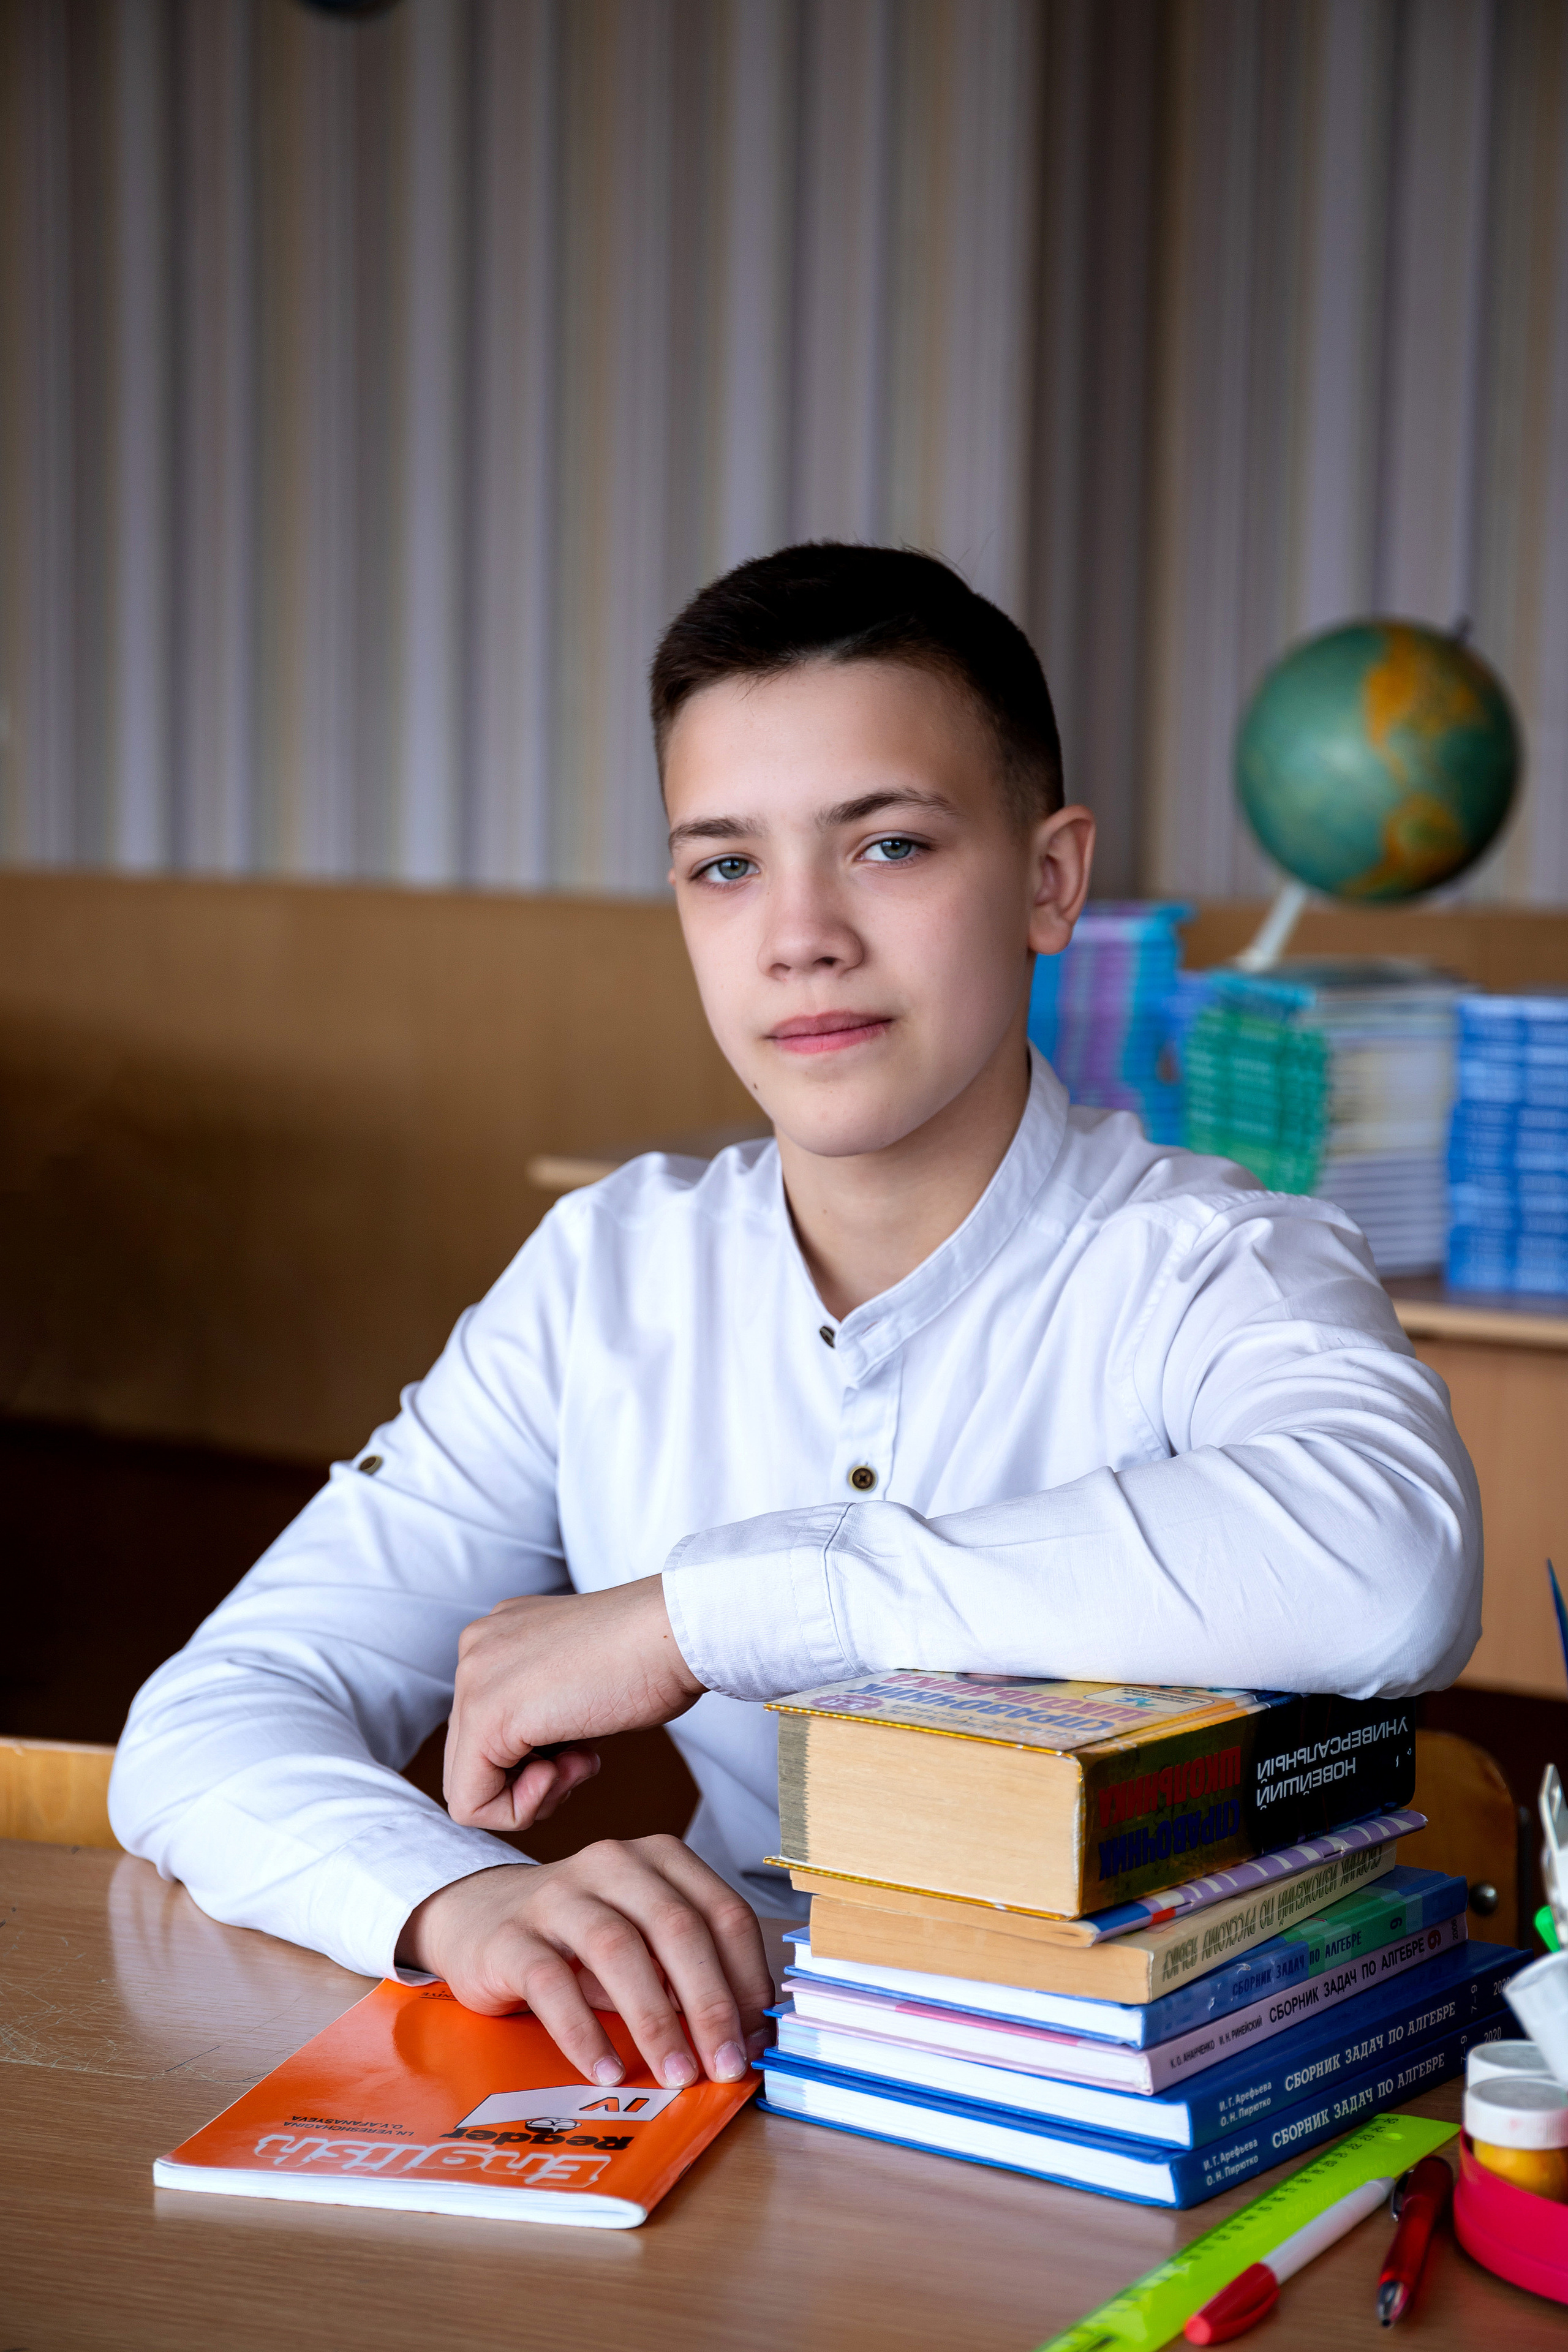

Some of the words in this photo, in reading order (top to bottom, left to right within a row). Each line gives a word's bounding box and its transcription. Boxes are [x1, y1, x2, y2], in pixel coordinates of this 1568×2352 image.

[845, 1683, 1115, 1731] СПРАВОЧНИК
[881, 1674, 1153, 1722] ШКОЛЬНИКА
[1257, 1717, 1408, 1784] УНИВЕРСАЛЬНЫЙ
[1099, 1746, 1242, 1828] ШКОЛЬНИКА
[1257, 1757, 1356, 1810] НОВЕЙШИЙ
[1099, 1799, 1240, 1881] СПРАВОЧНИК
[1340, 1844, 1381, 1887] СБОРНИК
[1259, 1897, 1275, 1930] ПО
[1278, 1863, 1338, 1928] ИЗЛОЖЕНИЙ
[1201, 1905, 1257, 1962] РУССКОМУ
[1390, 1917, 1403, 1930] 9
[1427, 1929, 1442, 1950] 9
[1162, 1936, 1199, 1983] ЯЗЫКУ
[1232, 1969, 1272, 1997] СБОРНИК
[1276, 1953, 1305, 1979] ЗАДАЧ
[1309, 1948, 1321, 1965] ПО
[1325, 1931, 1362, 1958] АЛГЕБРЕ
[1269, 1987, 1319, 2023] СБОРНИК
[1324, 1969, 1358, 1998] ЗАДАЧ
[1362, 1961, 1376, 1980] ПО
[1381, 1937, 1426, 1971] АЛГЕБРЕ
[1183, 2040, 1215, 2062] АНАНЧЕНКО
[1231, 2015, 1263, 2040] РИНЕЙСКИЙ
[1285, 2053, 1341, 2091] СБОРНИК
[1345, 2034, 1384, 2064] ЗАДАЧ
[1389, 2026, 1403, 2045] ПО
[1408, 2002, 1455, 2037] АЛГЕБРЕ
[579, 2097, 650, 2113] IV
[1219, 2100, 1227, 2113] И.
[1228, 2097, 1235, 2108] Г.
[1235, 2082, 1272, 2105] Арефьева
[1221, 2116, 1229, 2127] О.
[1229, 2113, 1238, 2124] Н.
[1238, 2098, 1272, 2119] Пирютко
[1272, 2109, 1330, 2149] СБОРНИК
[1333, 2088, 1373, 2119] ЗАДАЧ
[1378, 2079, 1393, 2098] ПО
[1398, 2053, 1444, 2089] АЛГЕБРЕ
[254, 2135, 611, 2188] English
[439, 2128, 635, 2151] Reader
[1203, 2159, 1212, 2171] И.
[1213, 2156, 1219, 2166] Г.
[1220, 2139, 1258, 2164] Арефьева
[1206, 2174, 1215, 2186] О.
[1215, 2171, 1224, 2183] Н.
[1225, 2155, 1259, 2177] Пирютко
